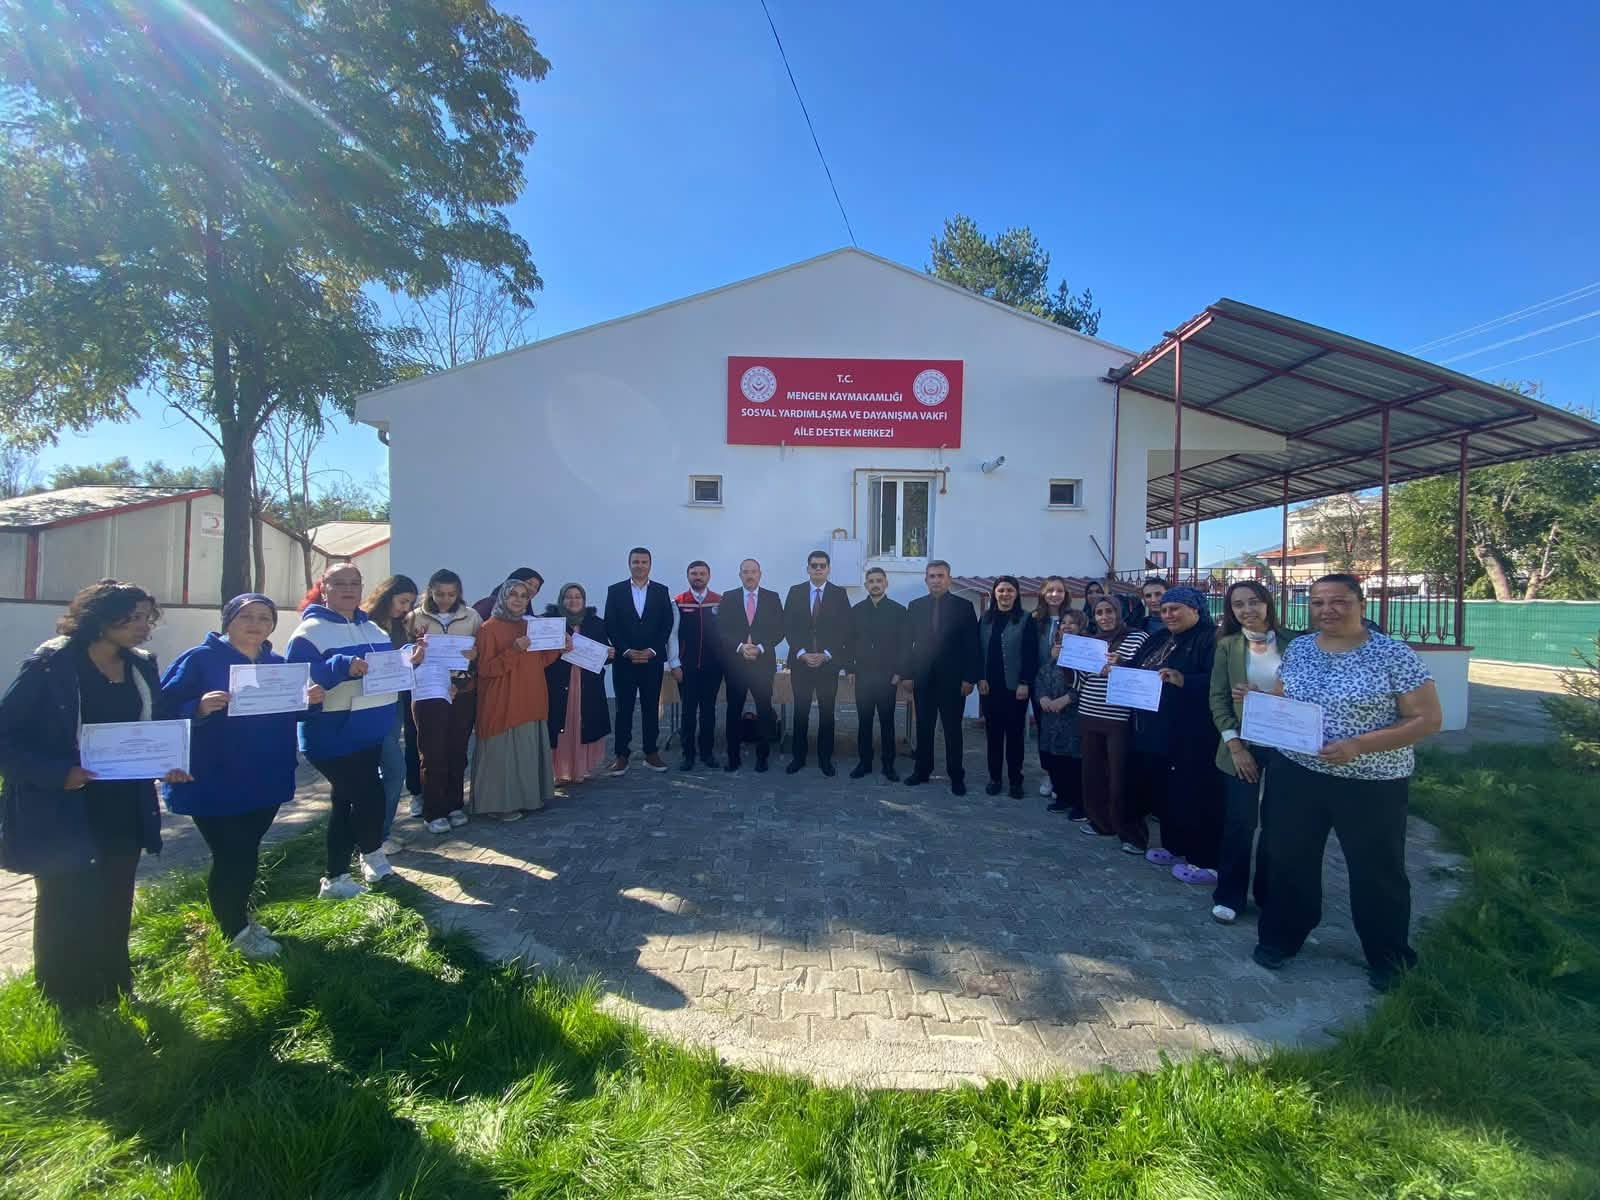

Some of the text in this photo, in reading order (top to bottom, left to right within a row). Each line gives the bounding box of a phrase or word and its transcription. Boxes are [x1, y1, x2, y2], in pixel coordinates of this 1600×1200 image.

[837, 375, 854, 383] T.C.
[787, 391, 902, 402] MENGEN KAYMAKAMLIĞI
[741, 408, 947, 421] SOSYAL YARDIMLAŞMA VE DAYANIŞMA VAKFI
[794, 427, 894, 438] AİLE DESTEK MERKEZİ
